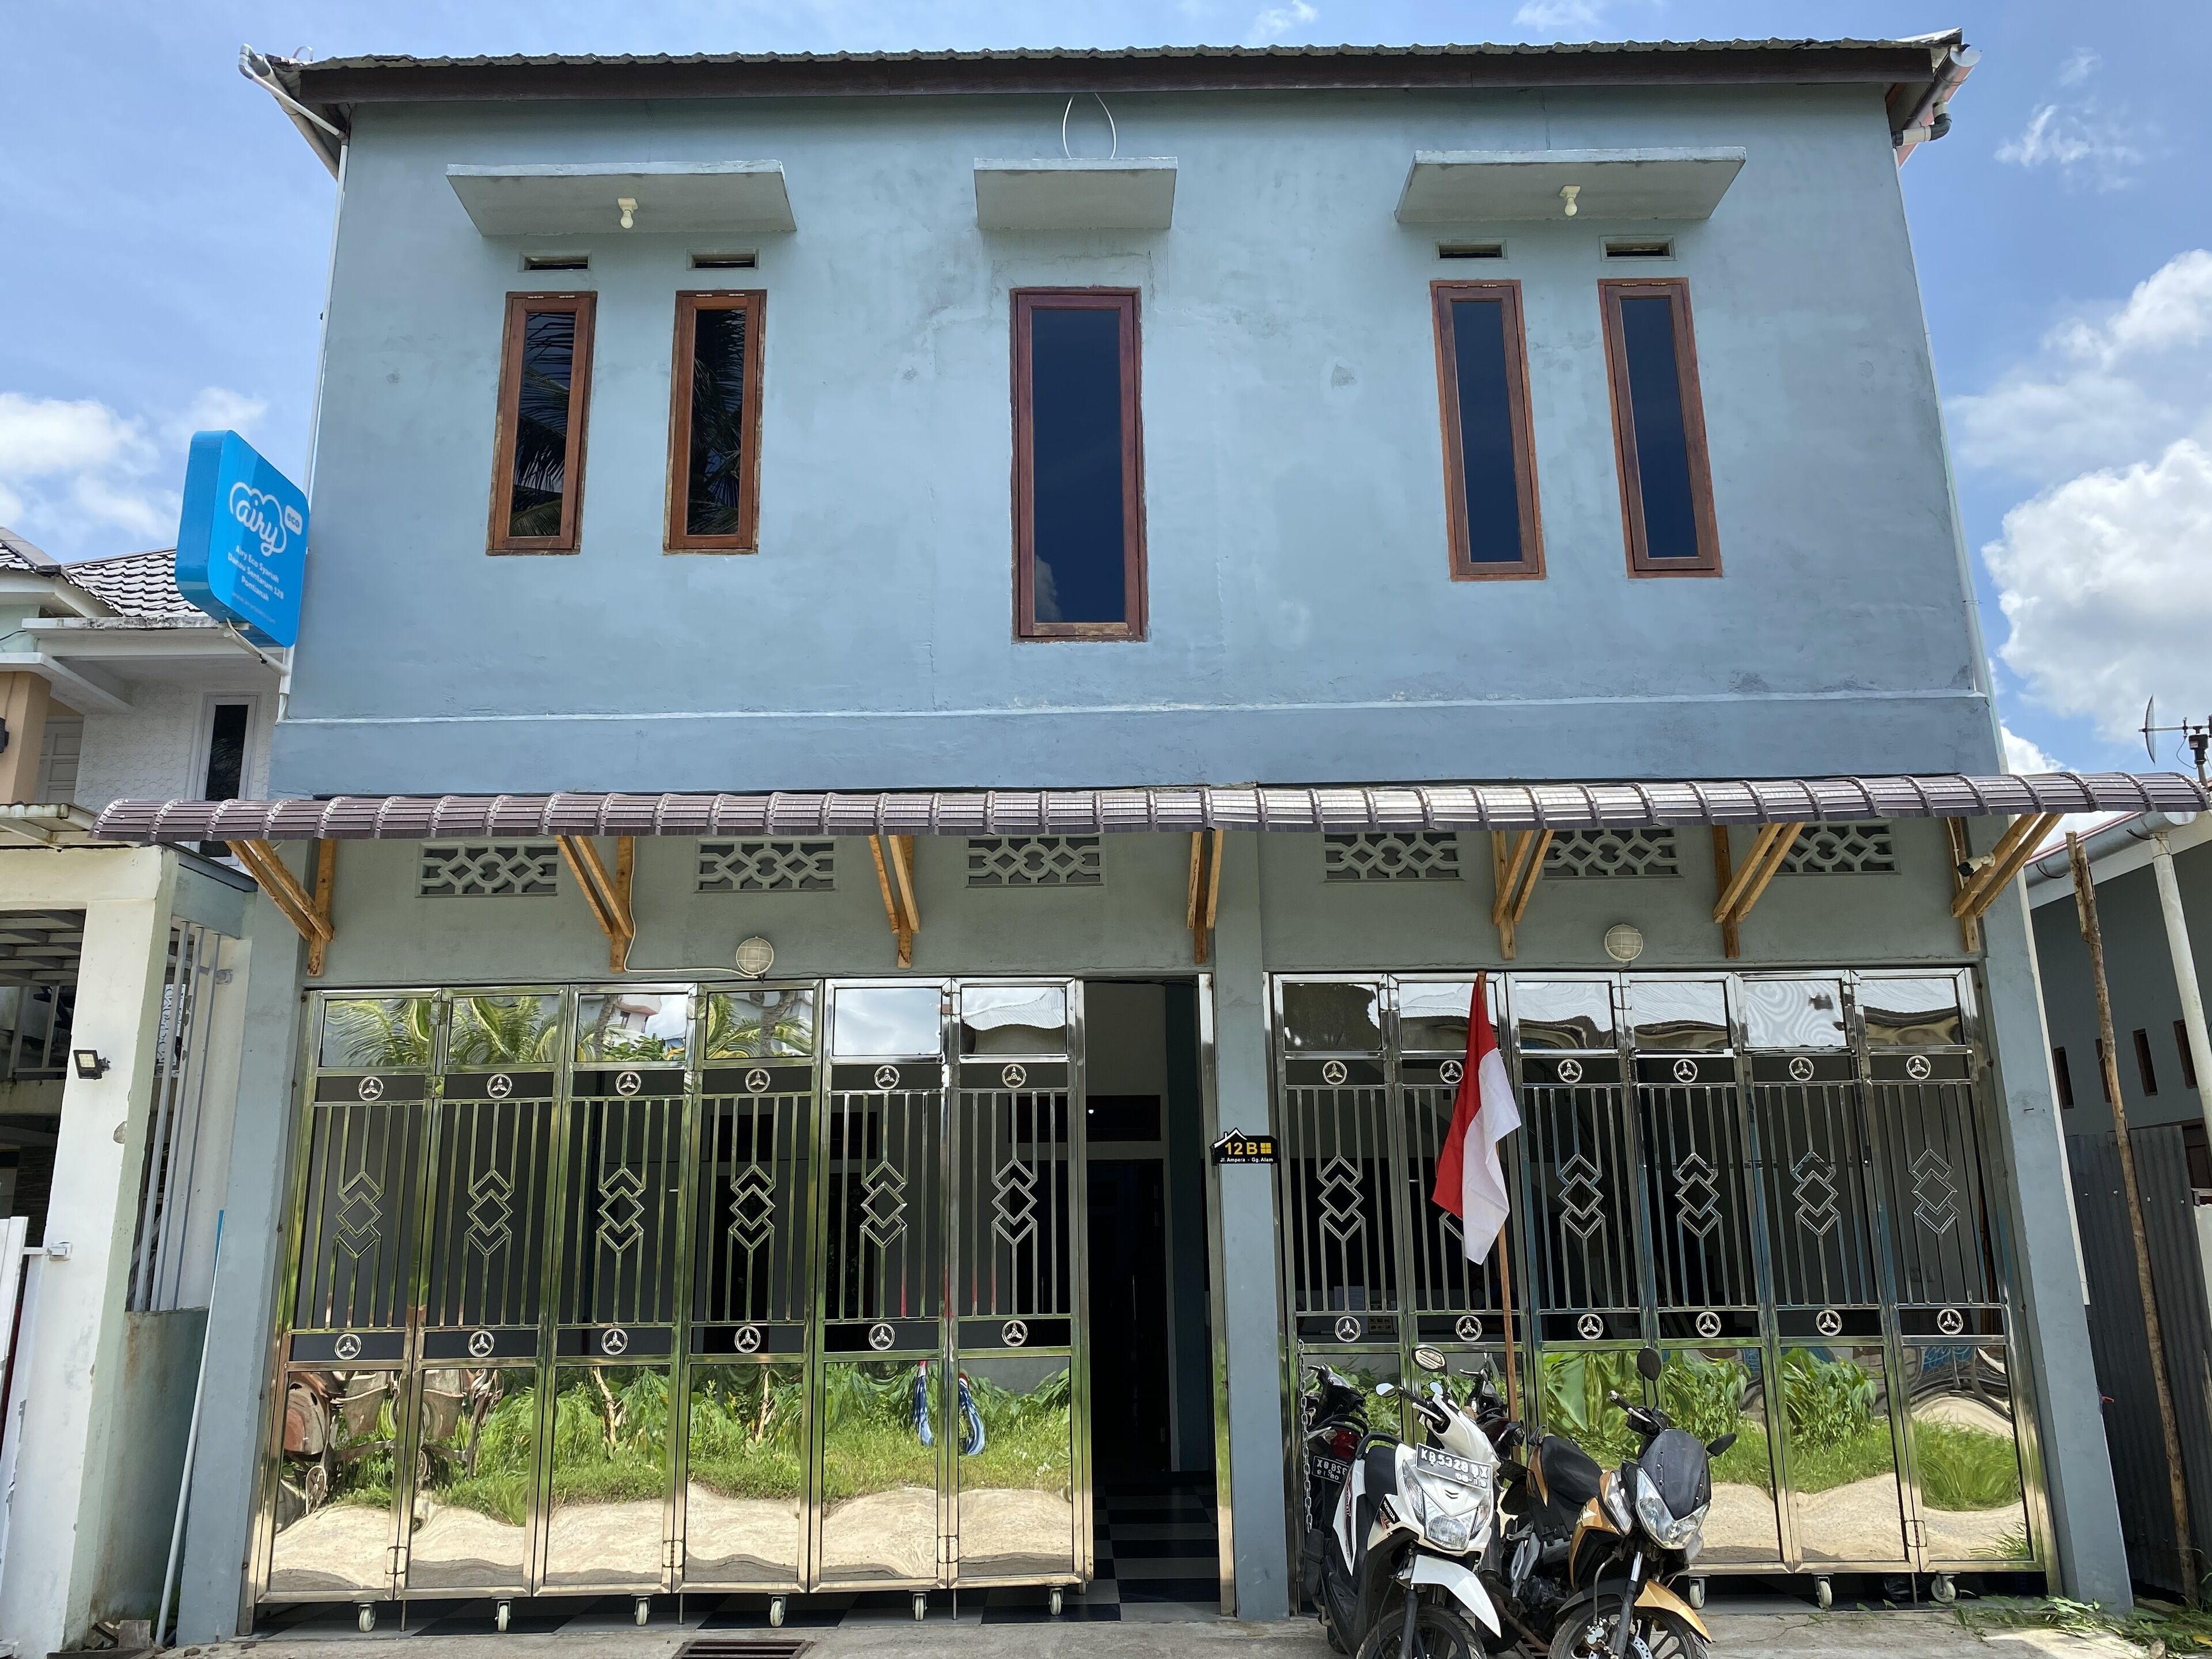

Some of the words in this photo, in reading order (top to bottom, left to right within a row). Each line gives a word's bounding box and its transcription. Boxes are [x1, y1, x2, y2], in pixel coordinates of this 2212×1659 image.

[236, 499, 278, 556] airy
[287, 513, 300, 528] eco
[228, 551, 246, 571] Danau
[247, 566, 274, 592] Sentarum
[274, 587, 284, 600] 12B
[236, 545, 247, 560] Airy
[248, 554, 258, 567] Eco
[259, 562, 279, 583] Syariah
[241, 575, 269, 602] Pontianak
[1421, 1448, 1436, 1463] KB
[1437, 1453, 1469, 1474] 5328
[1384, 1499, 1395, 1522] HONDA
